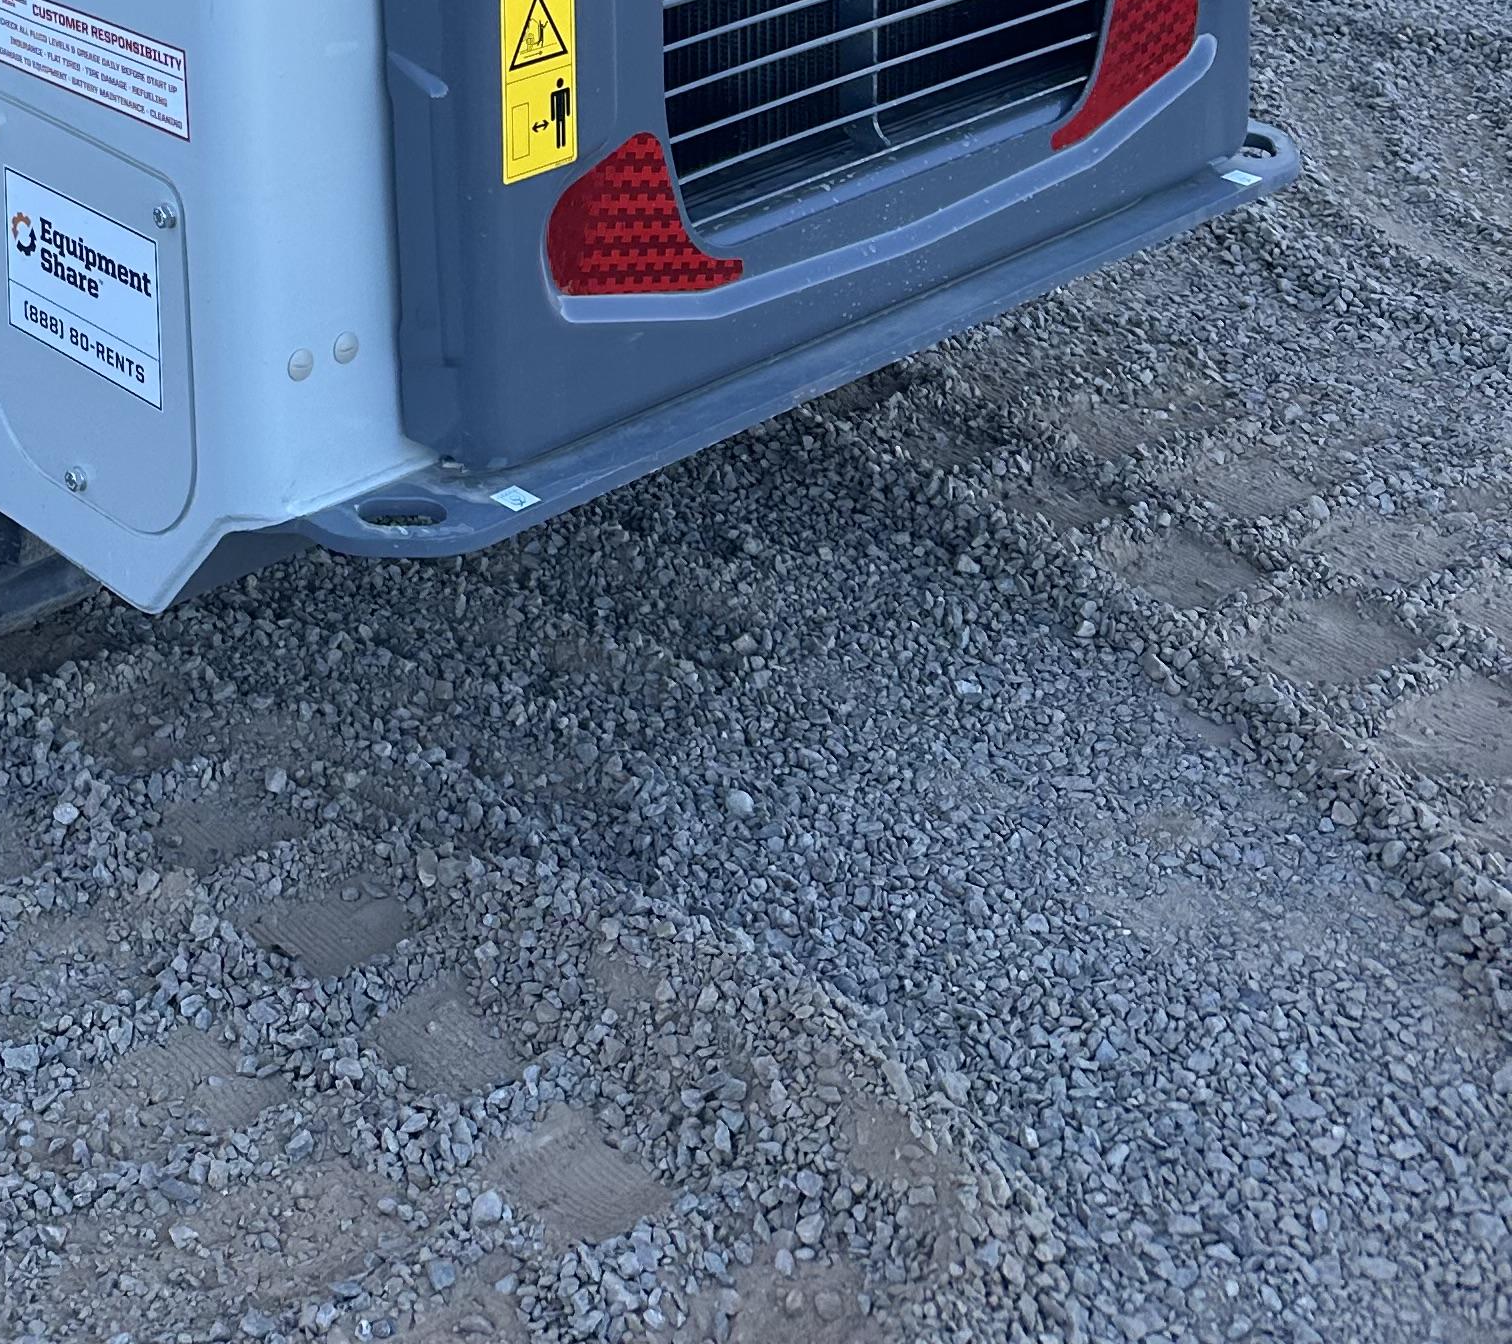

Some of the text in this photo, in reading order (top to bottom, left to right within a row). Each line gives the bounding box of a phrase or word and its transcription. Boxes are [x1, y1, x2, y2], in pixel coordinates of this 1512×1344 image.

[0, 17, 18, 31] CHECK
[49, 37, 70, 54] LEVELS
[77, 48, 101, 64] GREASE
[102, 57, 120, 72] DAILY
[121, 64, 145, 82] BEFORE
[147, 74, 167, 90] START
[169, 83, 178, 93] UP
[32, 4, 182, 71] CUSTOMER RESPONSIBILITY
[24, 57, 31, 67] TO
[72, 77, 98, 95] BATTERY
[99, 87, 145, 114] MAINTENANCE
[47, 52, 61, 64] FLAT
[85, 66, 100, 79] TIRE
[101, 73, 127, 91] DAMAGE
[132, 85, 168, 107] REFUELING
[39, 216, 152, 298] Equipment
[40, 248, 99, 298] Share
[23, 300, 145, 383] (888) 80-RENTS
